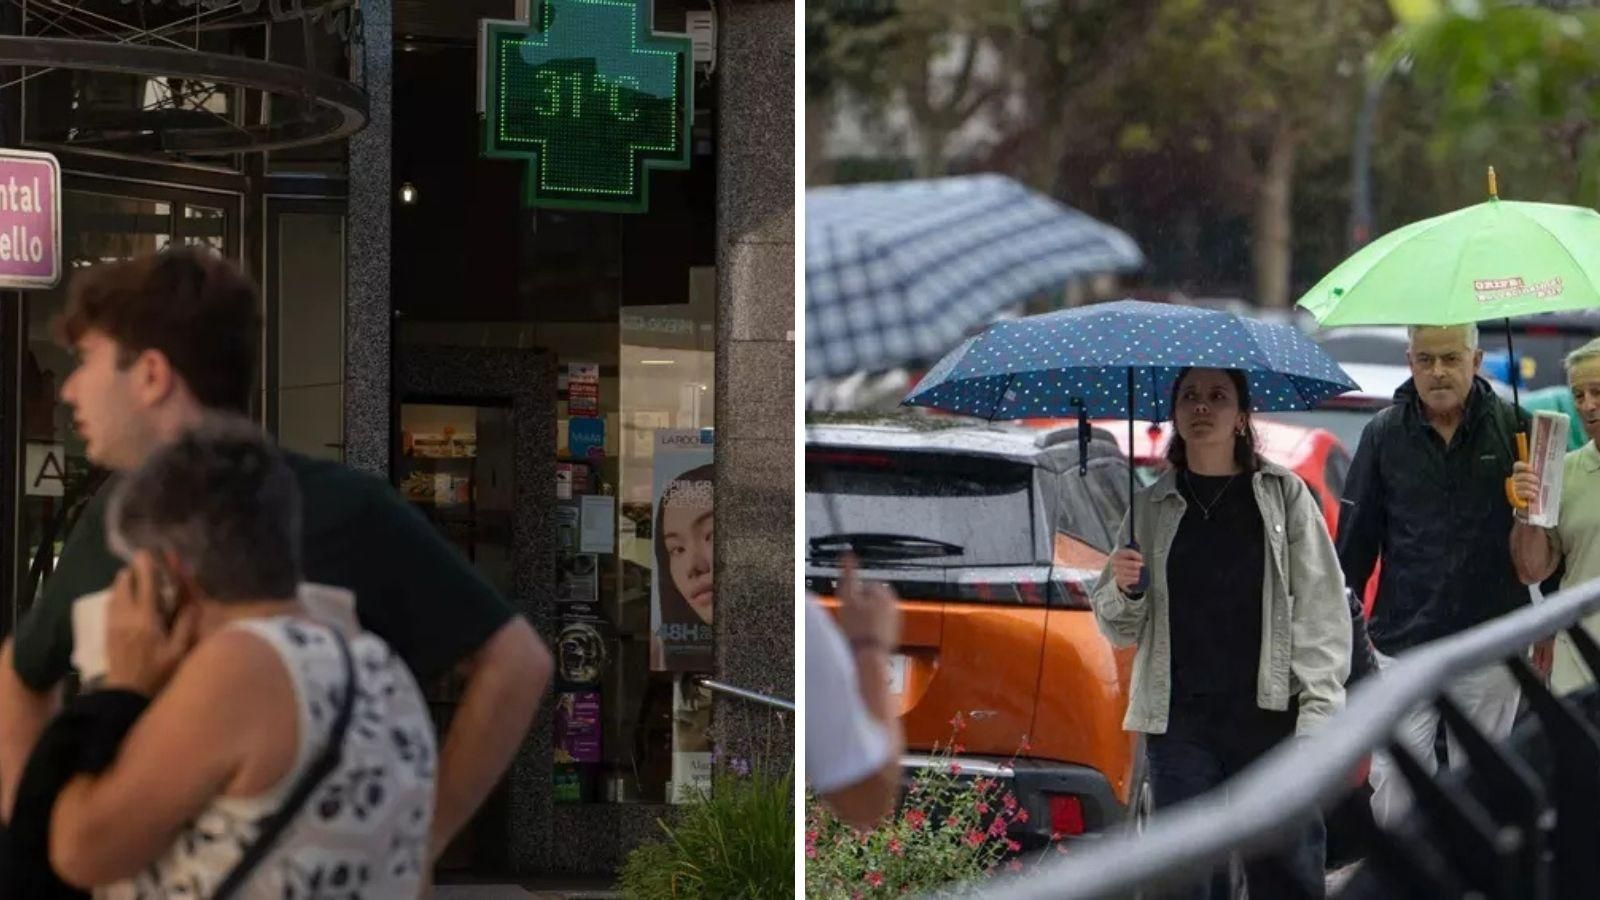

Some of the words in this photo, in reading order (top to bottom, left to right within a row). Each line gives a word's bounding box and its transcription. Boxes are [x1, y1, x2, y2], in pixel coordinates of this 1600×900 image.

[0, 225, 42, 263] ello
[678, 435, 702, 446] ROC
[33, 451, 68, 488] A
[656, 622, 698, 641] 48H
